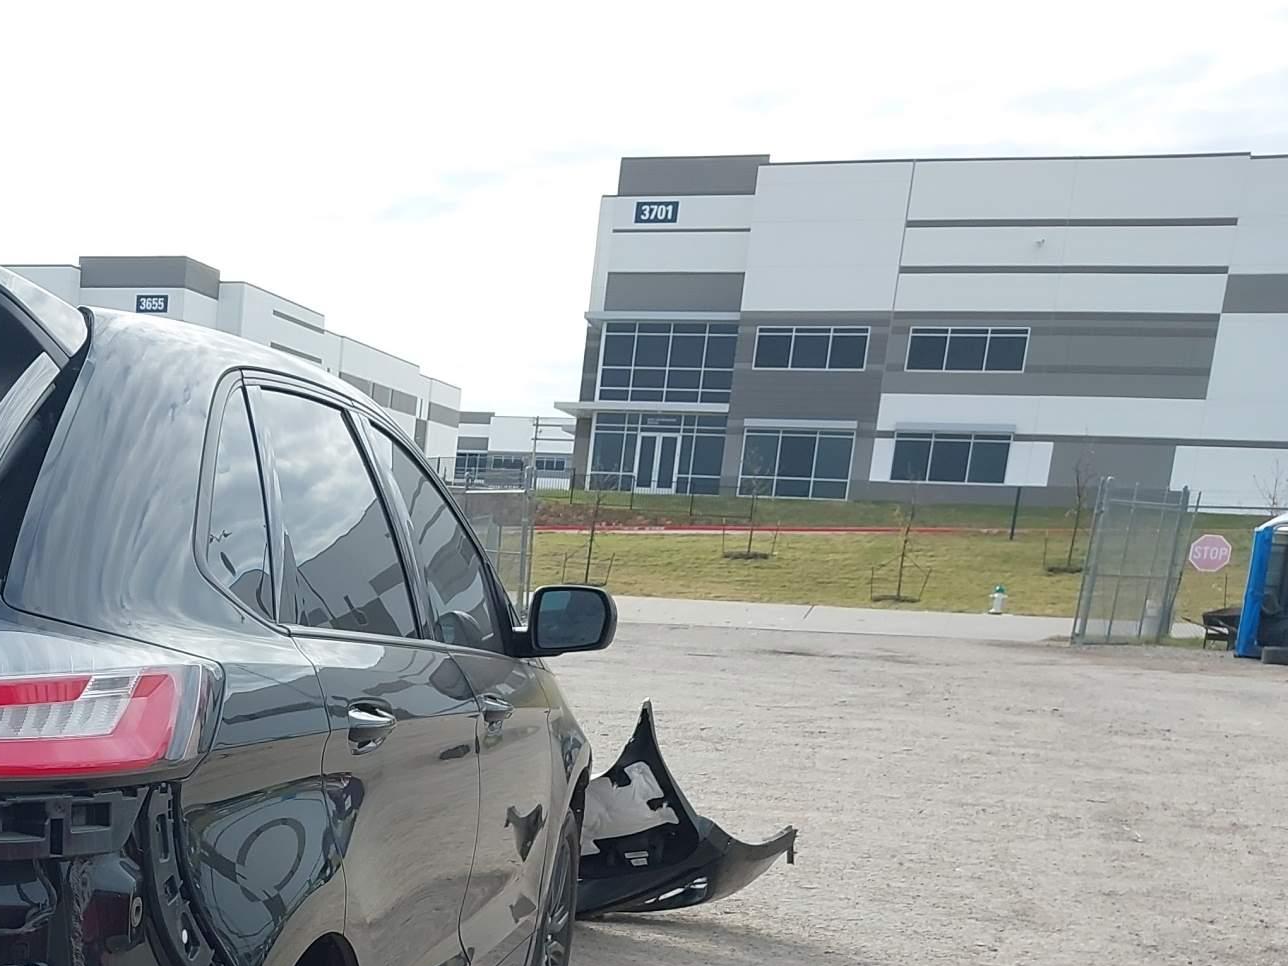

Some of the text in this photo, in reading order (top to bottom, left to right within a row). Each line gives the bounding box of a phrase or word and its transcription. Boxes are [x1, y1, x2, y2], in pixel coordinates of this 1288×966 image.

[640, 204, 673, 220] 3701
[139, 297, 165, 310] 3655
[1193, 546, 1229, 560] STOP
